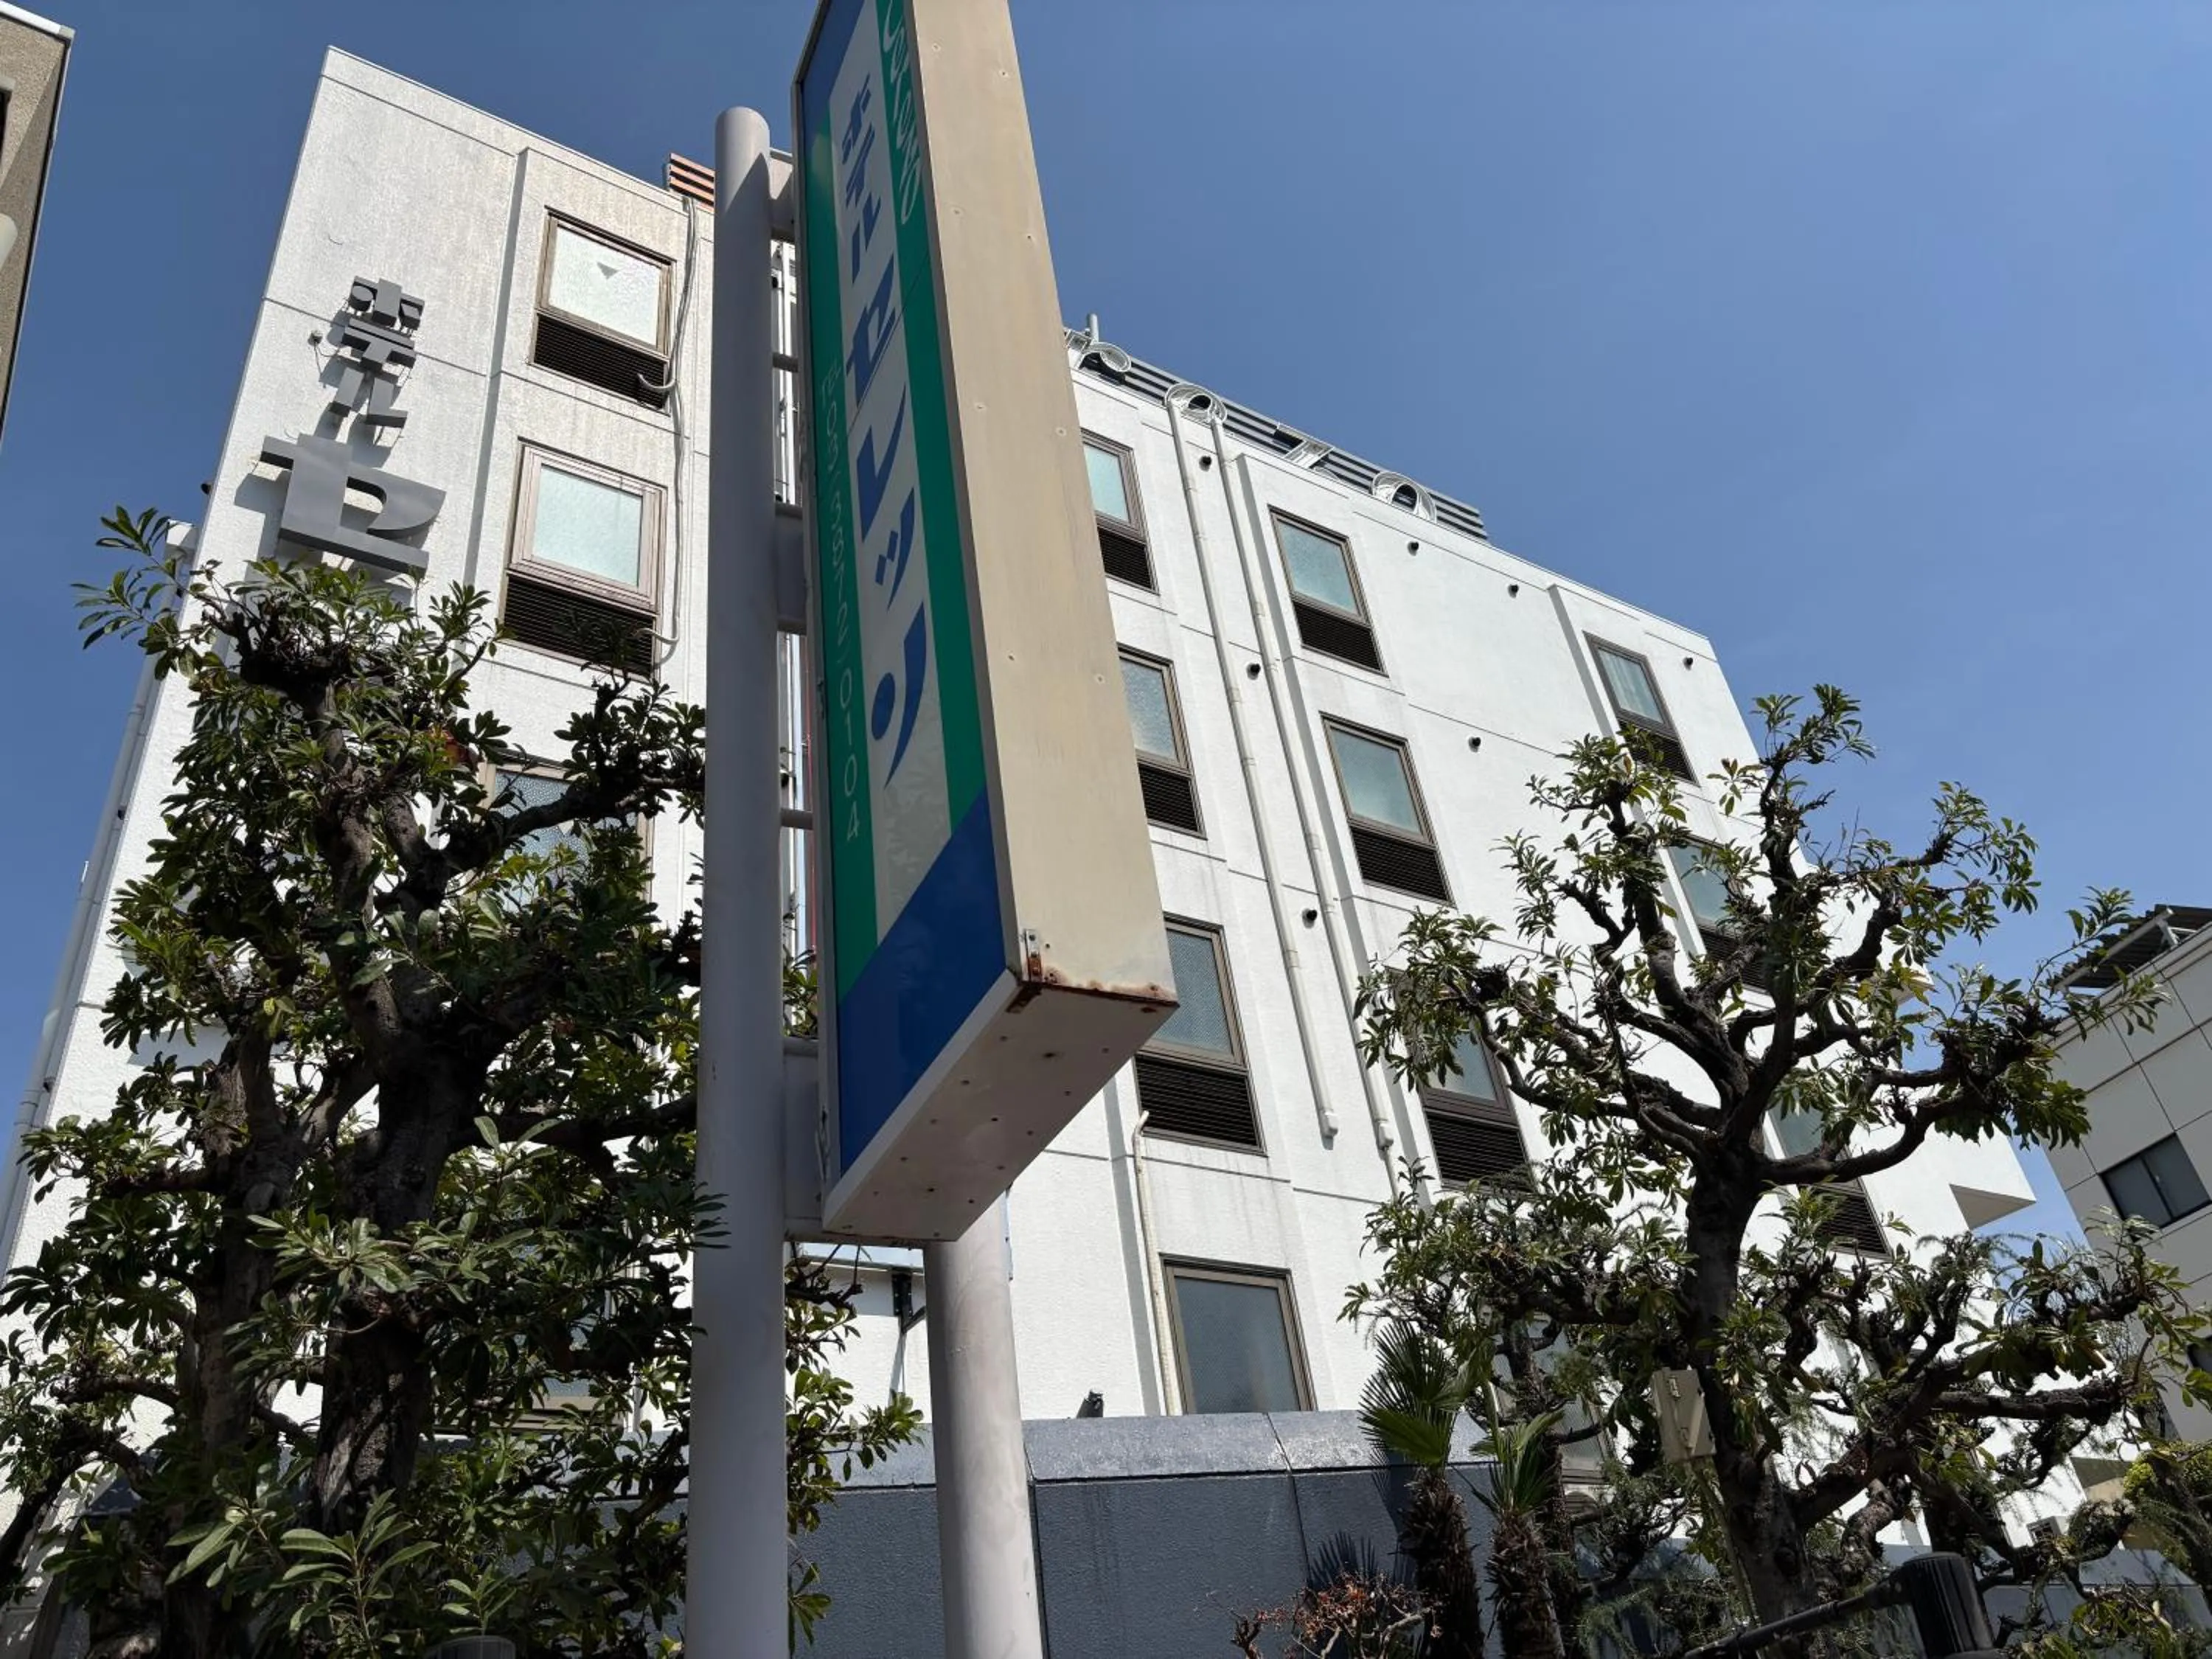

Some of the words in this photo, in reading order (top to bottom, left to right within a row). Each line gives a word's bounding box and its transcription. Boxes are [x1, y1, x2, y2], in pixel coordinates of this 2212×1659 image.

[821, 358, 842, 408] TEL
[842, 72, 927, 789] ホテルセレッソ
